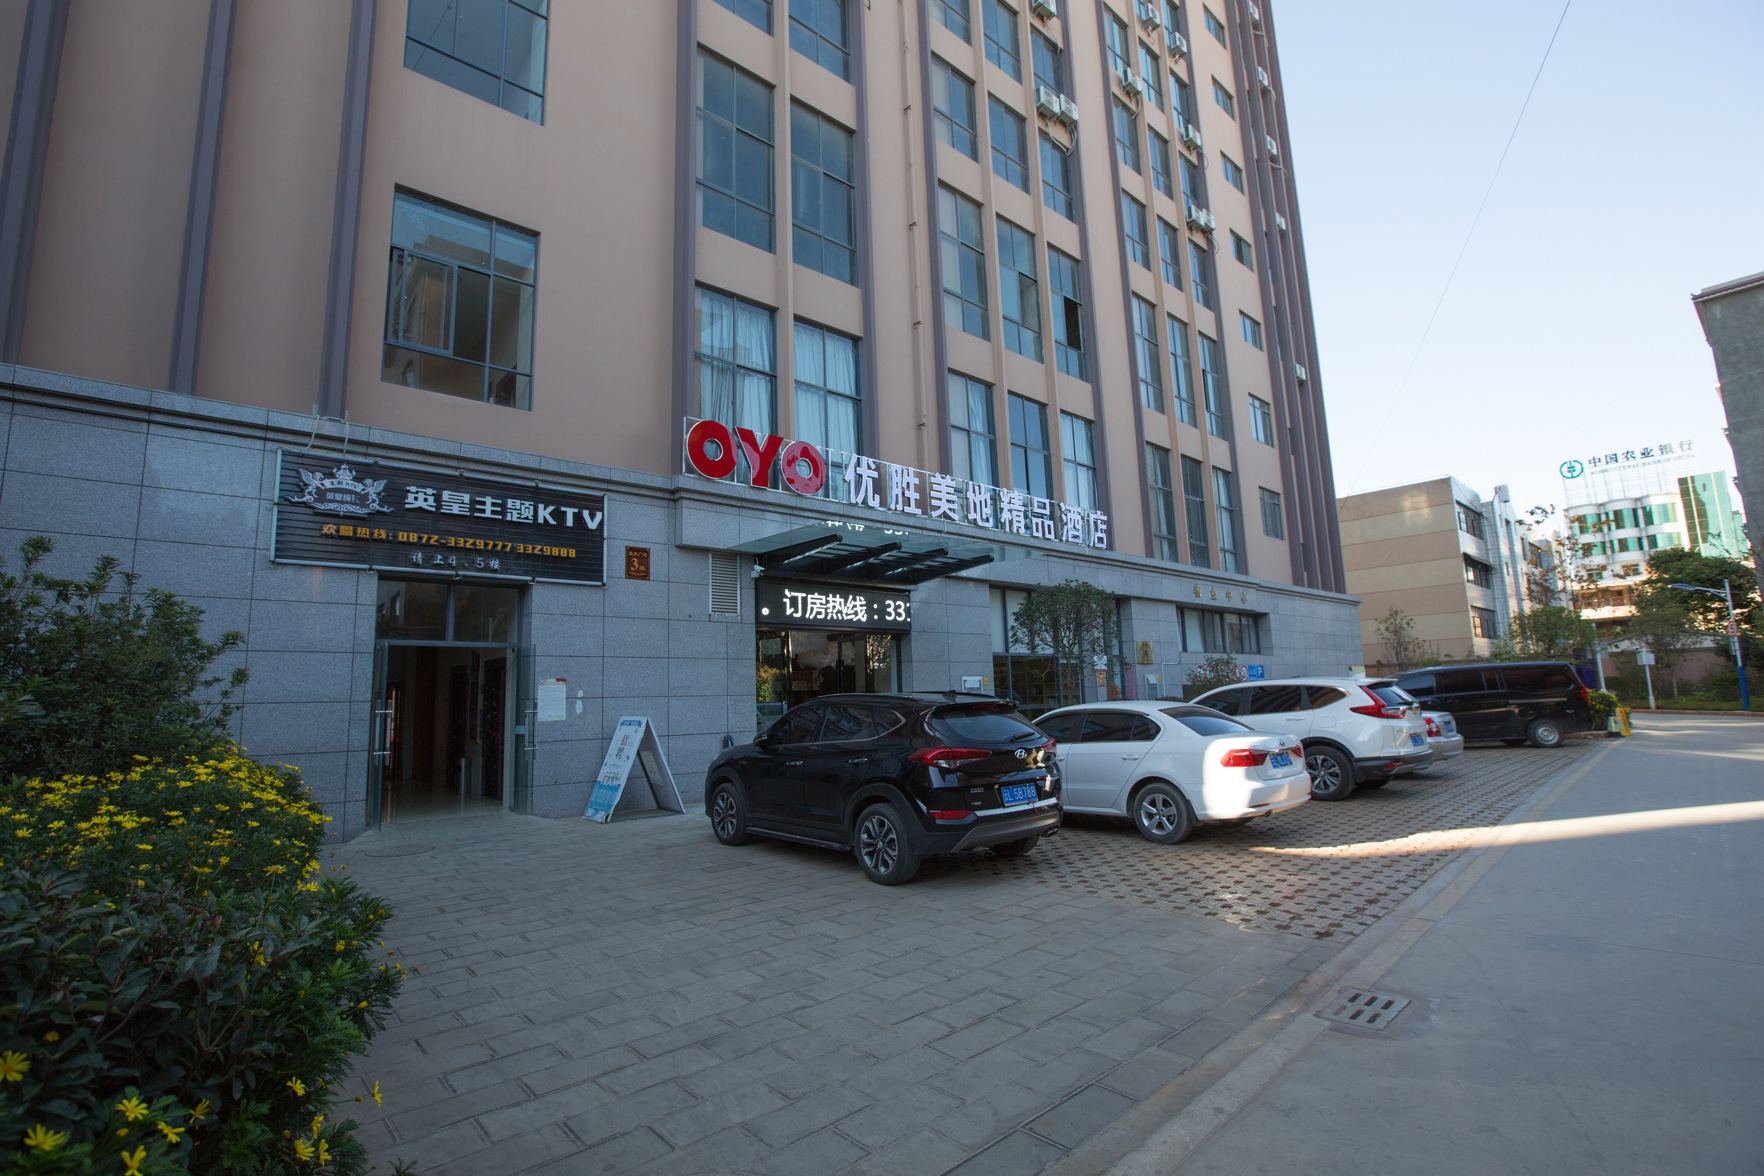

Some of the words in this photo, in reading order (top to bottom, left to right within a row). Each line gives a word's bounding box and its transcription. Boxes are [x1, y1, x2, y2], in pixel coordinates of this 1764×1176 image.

[1588, 440, 1693, 467] 中国农业银行
[686, 419, 827, 496] OYO
[844, 453, 1108, 549] 优胜美地精品酒店
[404, 485, 604, 530] 英皇主题KTV
[516, 543, 577, 558] 3329888
